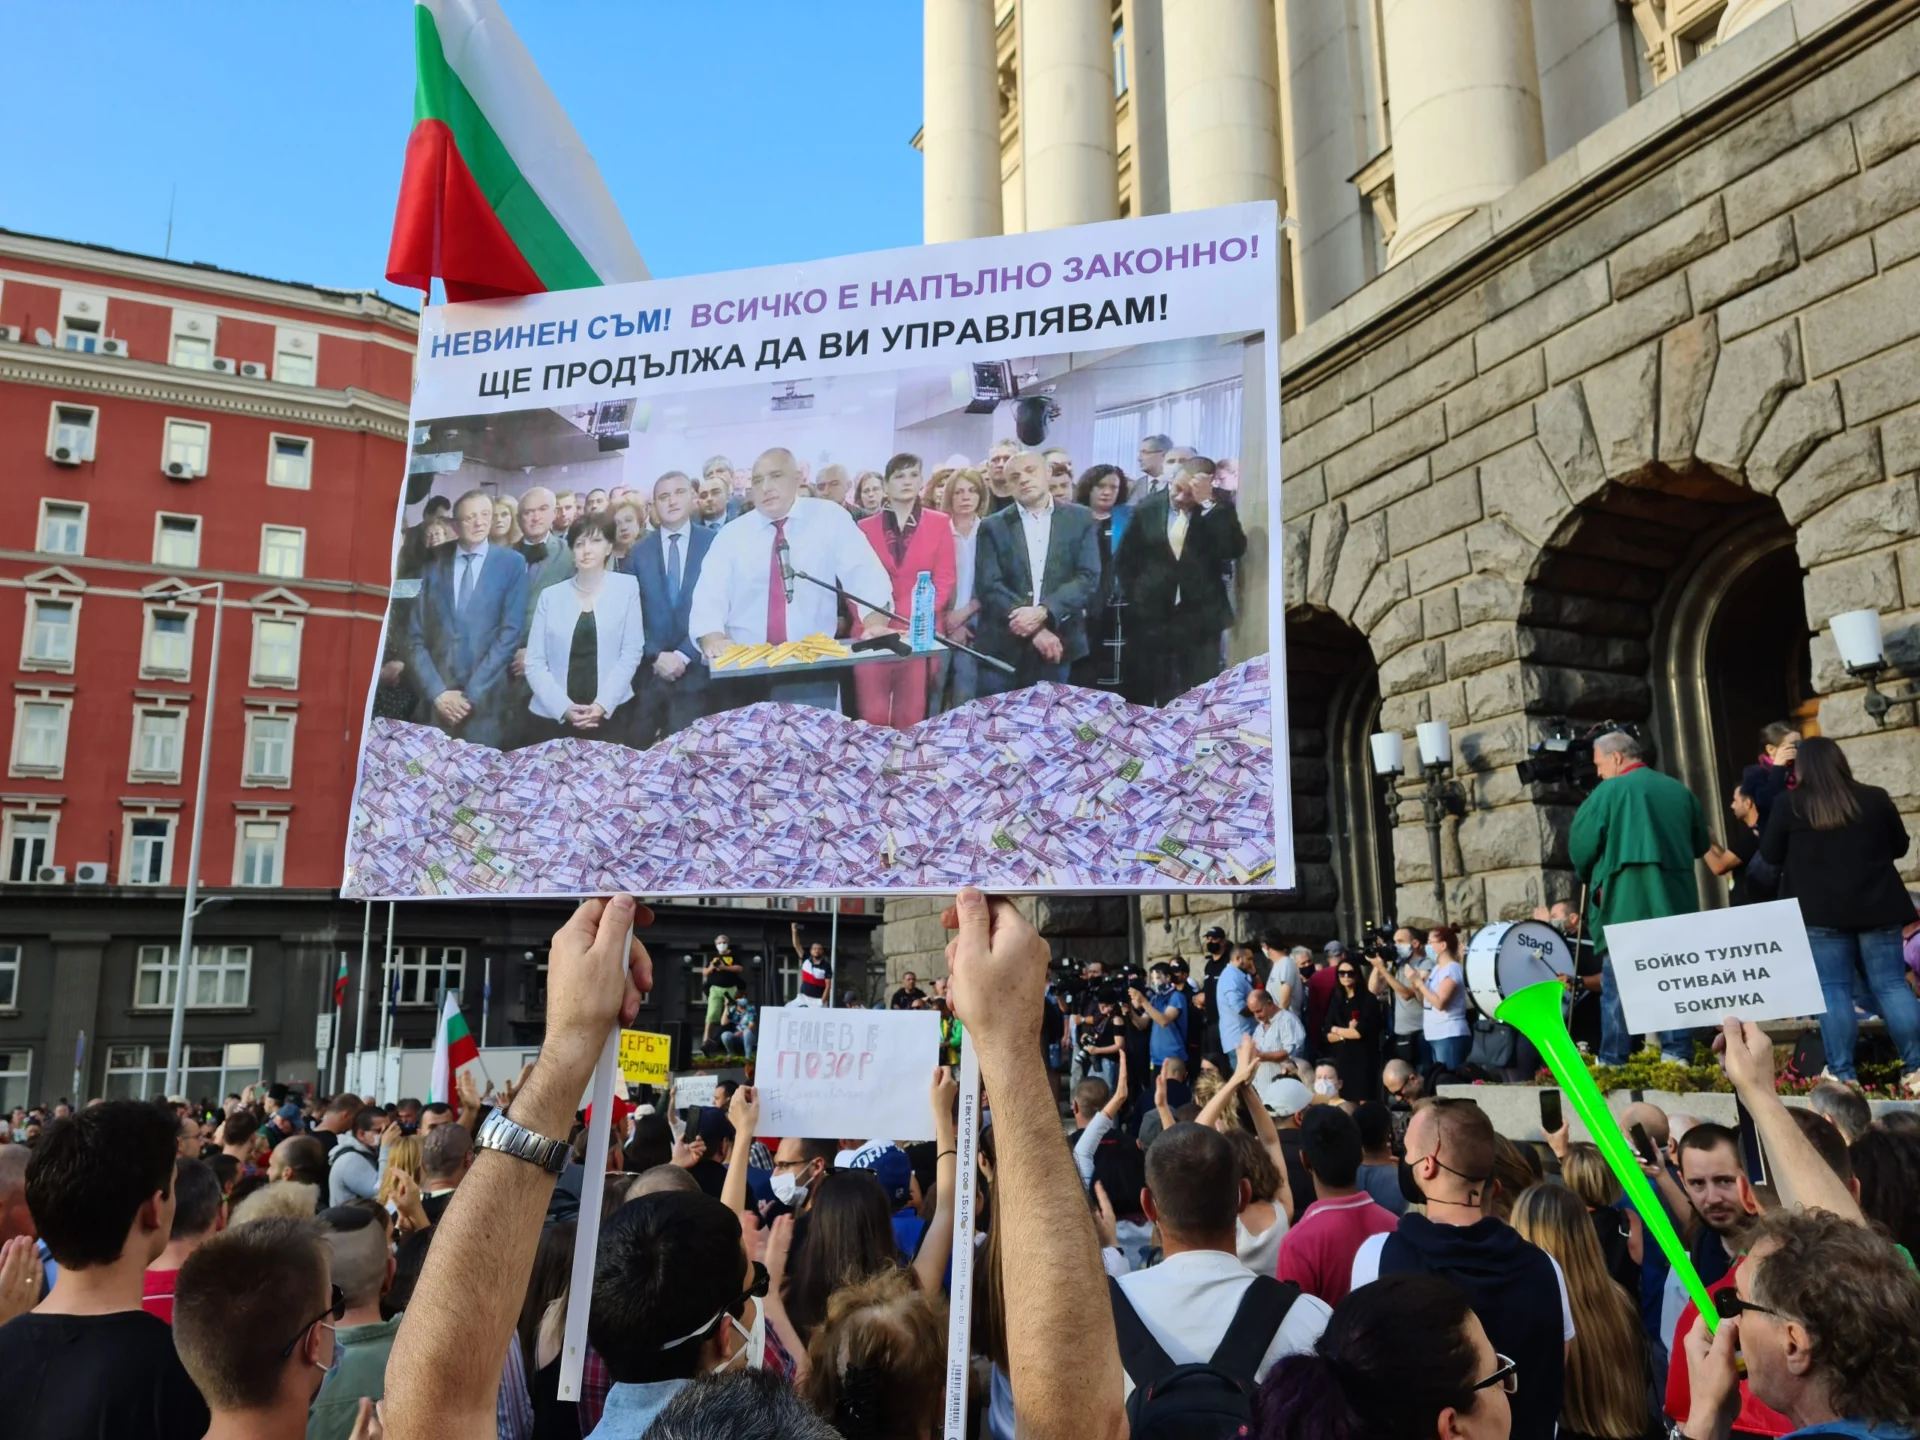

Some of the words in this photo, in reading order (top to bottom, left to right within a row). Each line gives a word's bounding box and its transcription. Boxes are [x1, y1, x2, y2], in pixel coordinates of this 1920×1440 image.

[430, 322, 577, 359] НЕВИНЕН
[587, 307, 672, 339] СЪМ!
[690, 287, 829, 329] ВСИЧКО
[838, 283, 859, 310] Е
[870, 261, 1052, 307] НАПЪЛНО
[1062, 234, 1260, 283] ЗАКОННО!
[478, 366, 531, 400] ЩЕ
[542, 344, 746, 392] ПРОДЪЛЖА
[754, 336, 808, 371] ДА
[818, 328, 869, 360] ВИ
[882, 294, 1168, 354] УПРАВЛЯВАМ!
[1634, 952, 1700, 972] БОЙКО
[1705, 940, 1783, 962] ТУЛУПА
[1657, 968, 1737, 992] ОТИВАЙ
[1744, 967, 1771, 981] НА
[1674, 992, 1765, 1014] БОКЛУКА
[777, 1051, 874, 1080] ПОЗОР
[963, 1095, 973, 1189] Elektroresurs.co
